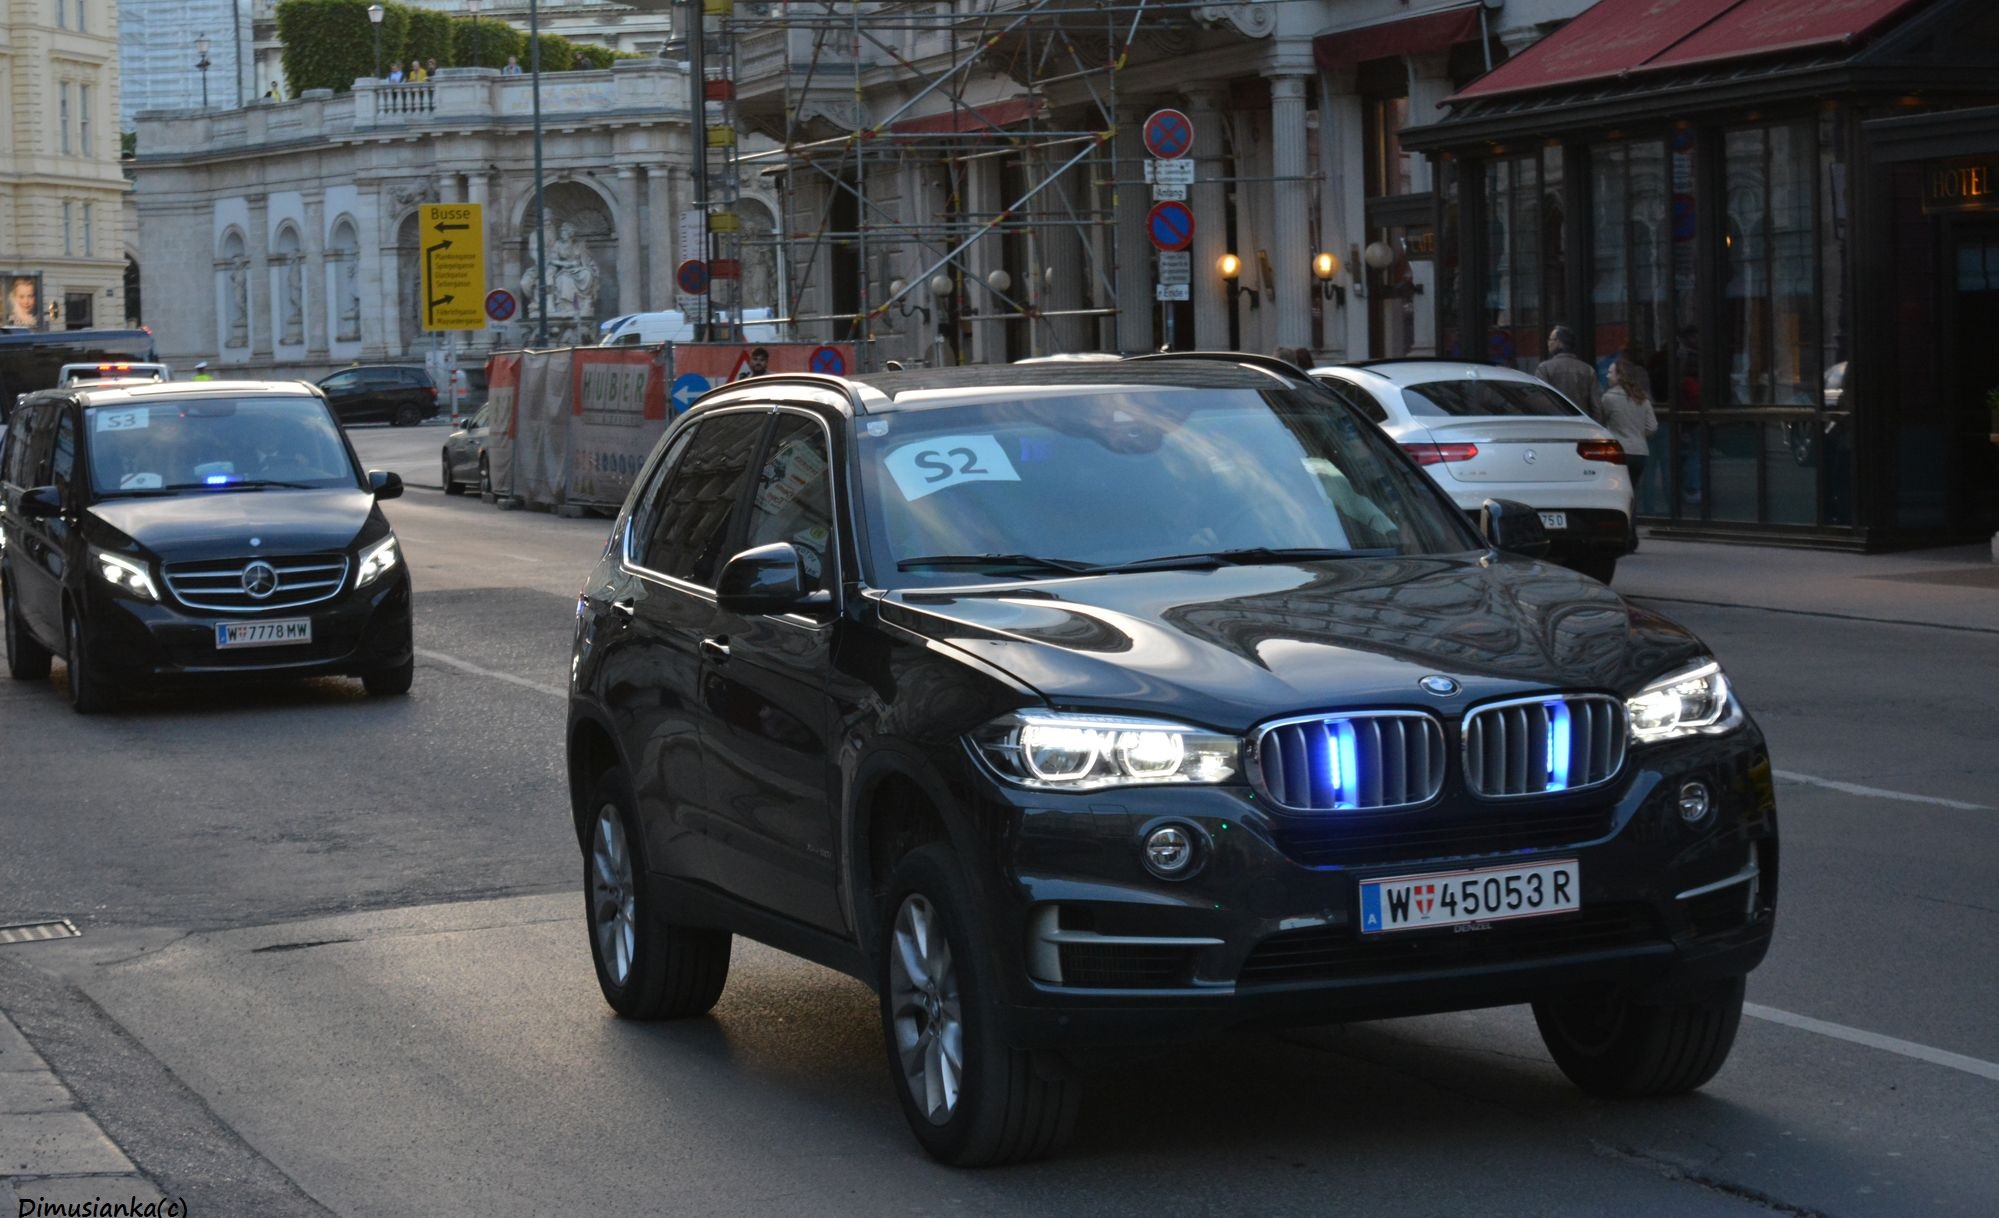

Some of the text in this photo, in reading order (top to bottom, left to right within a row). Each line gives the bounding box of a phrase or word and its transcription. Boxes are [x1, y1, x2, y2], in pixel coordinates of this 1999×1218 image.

[1932, 166, 1993, 198] HOTEL
[431, 207, 471, 220] Busse
[1163, 287, 1184, 297] Ende
[583, 371, 645, 403] HUBER
[107, 413, 136, 428] S3
[914, 447, 989, 484] S2
[227, 627, 237, 641] W
[249, 624, 284, 640] 7778
[287, 623, 307, 638] MW
[1367, 870, 1571, 925] A W 45053 R
